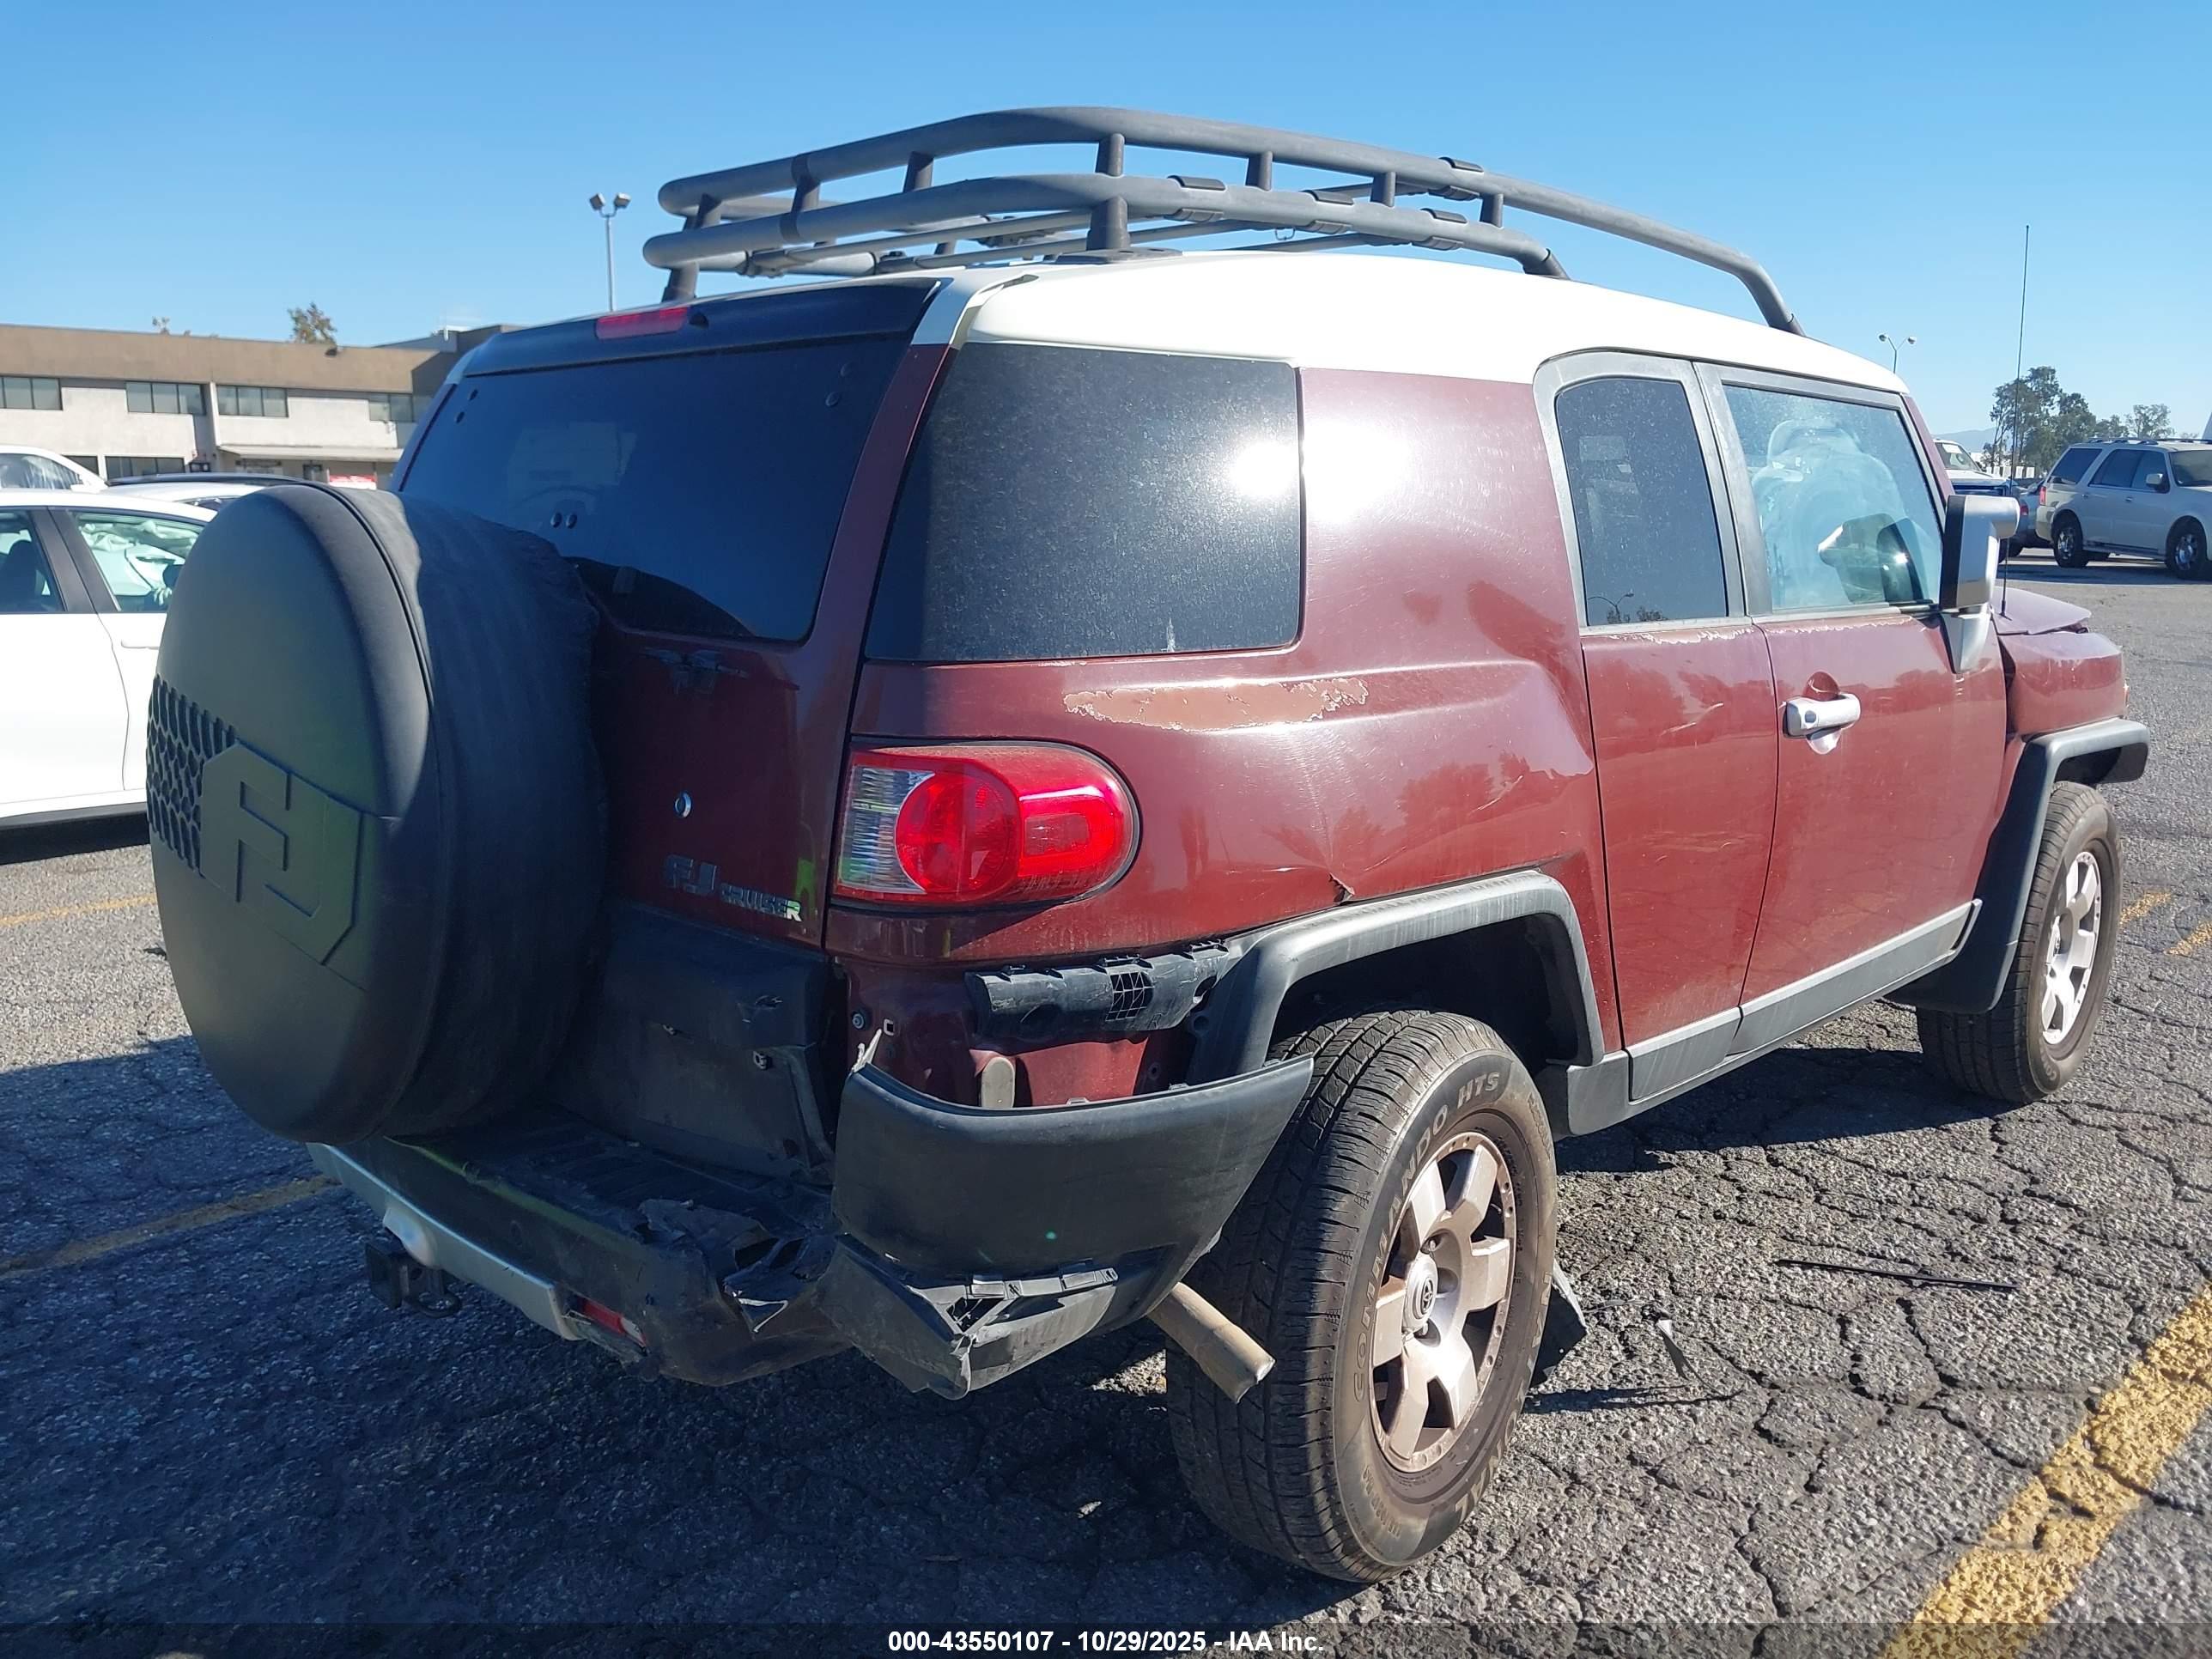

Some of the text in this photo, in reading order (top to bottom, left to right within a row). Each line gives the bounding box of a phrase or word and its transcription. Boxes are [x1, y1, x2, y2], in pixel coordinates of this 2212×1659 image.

[720, 882, 803, 922] CRUISER
[1353, 1103, 1449, 1402] COMMANDO
[1456, 1072, 1500, 1109] HTS
